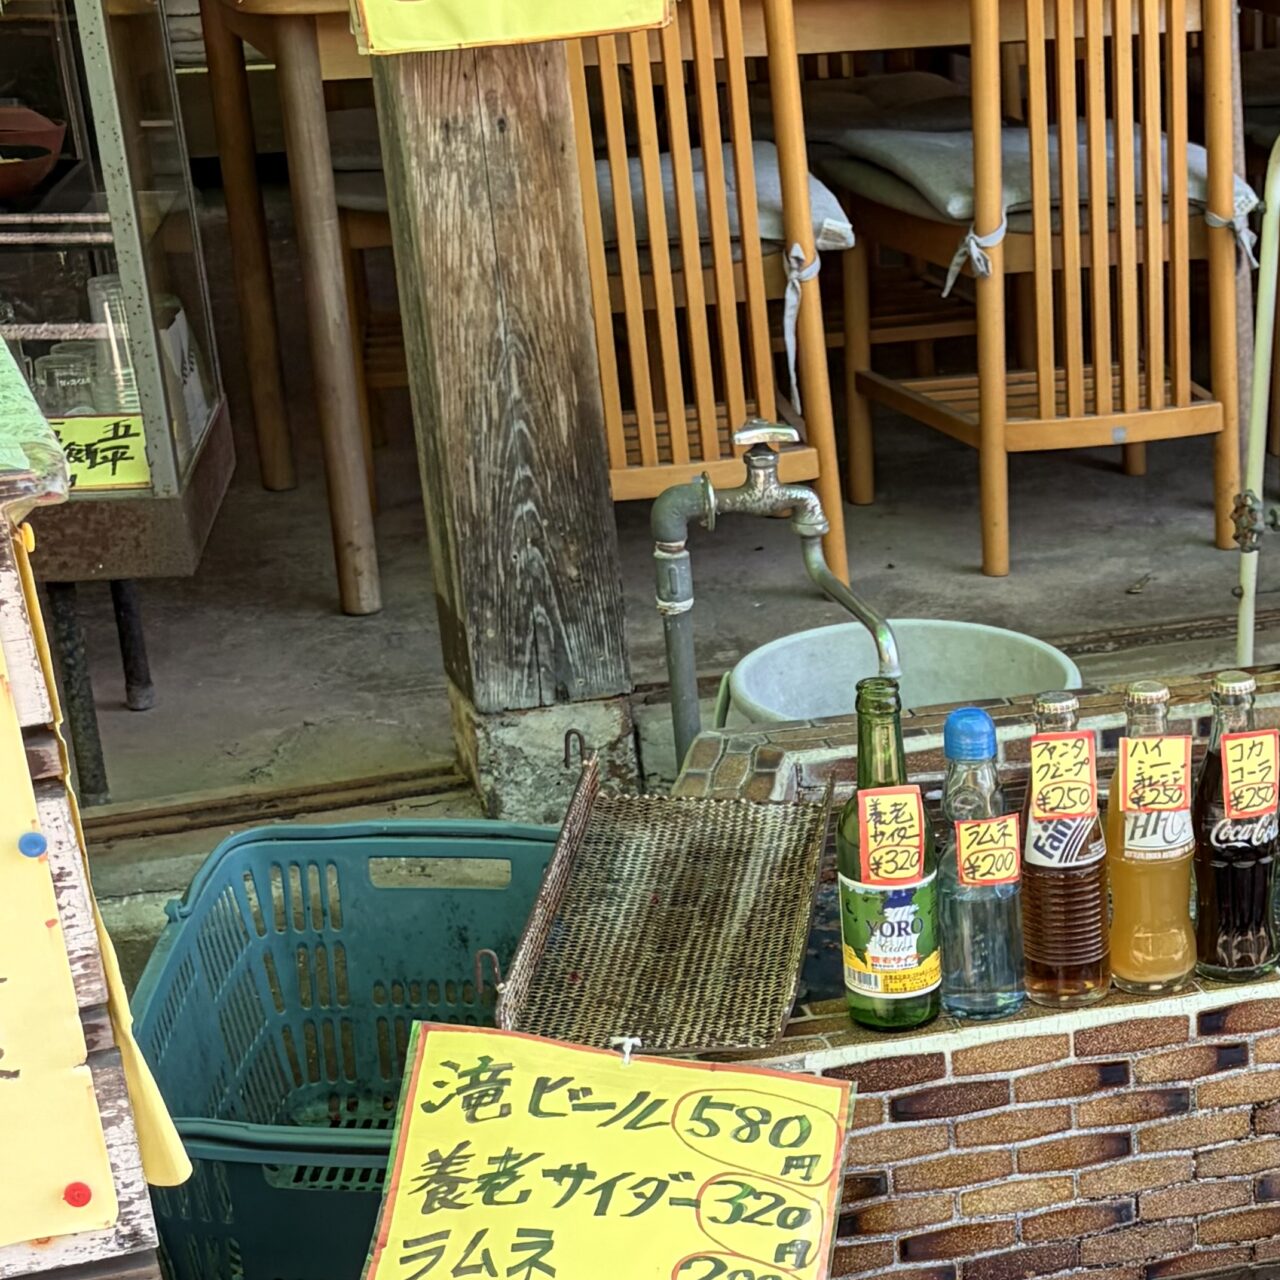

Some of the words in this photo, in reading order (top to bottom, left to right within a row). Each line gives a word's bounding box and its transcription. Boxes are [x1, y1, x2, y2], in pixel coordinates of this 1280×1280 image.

[1033, 738, 1085, 760] ファンタ
[1130, 738, 1163, 757] ハイ
[1230, 741, 1264, 762] コカ
[1036, 757, 1090, 782] グレープ
[1230, 759, 1272, 784] コーラ
[1037, 787, 1090, 813] ¥250
[1132, 787, 1183, 809] ¥250
[1231, 786, 1275, 811] ¥250
[867, 799, 914, 826] 養老
[870, 824, 920, 847] サイダー
[964, 819, 1013, 849] ラムネ
[1033, 818, 1077, 860] Fan
[870, 850, 920, 877] ¥320
[964, 852, 1014, 880] ¥200
[866, 917, 924, 938] YORO
[879, 942, 913, 954] Cider
[420, 1056, 673, 1132] 滝ビール
[408, 1141, 699, 1218] 養老サイダー
